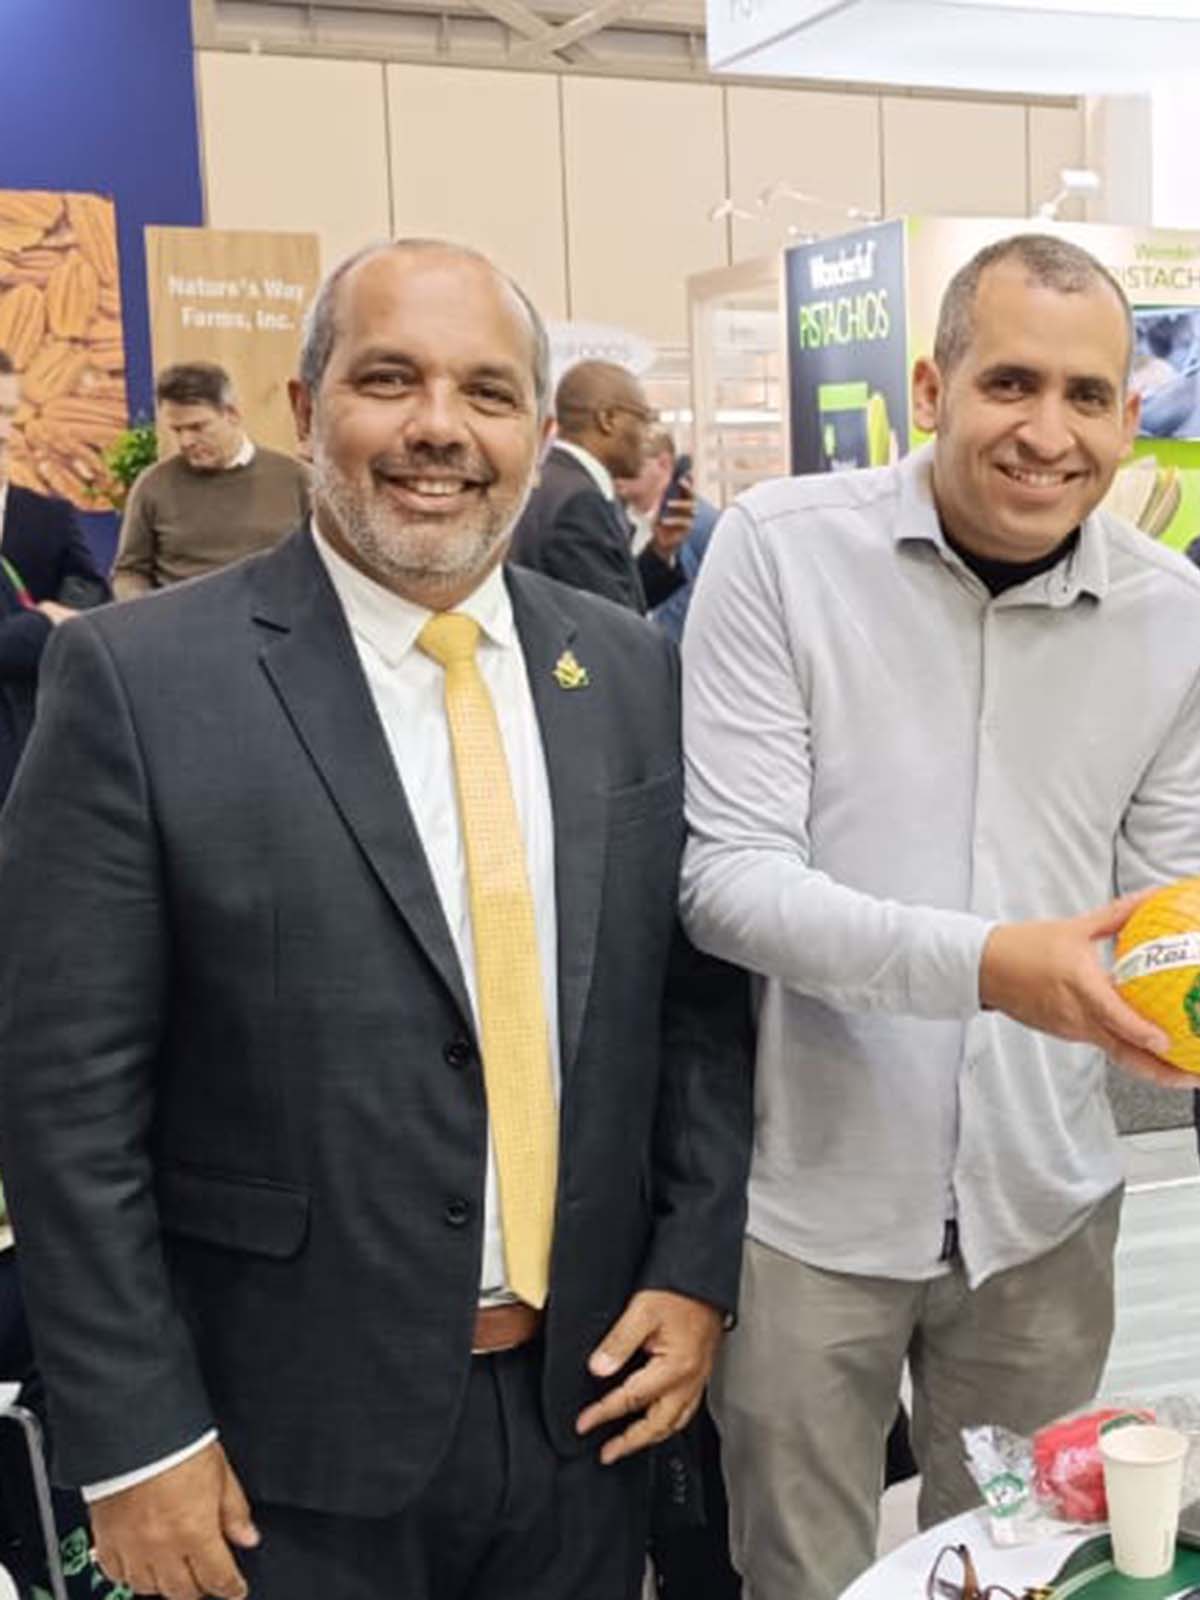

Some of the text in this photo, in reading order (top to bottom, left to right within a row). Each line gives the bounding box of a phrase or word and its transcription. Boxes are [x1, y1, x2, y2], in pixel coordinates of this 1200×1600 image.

[168, 275, 305, 304] Nature's Way
[181, 306, 296, 331] Farms, Inc.
